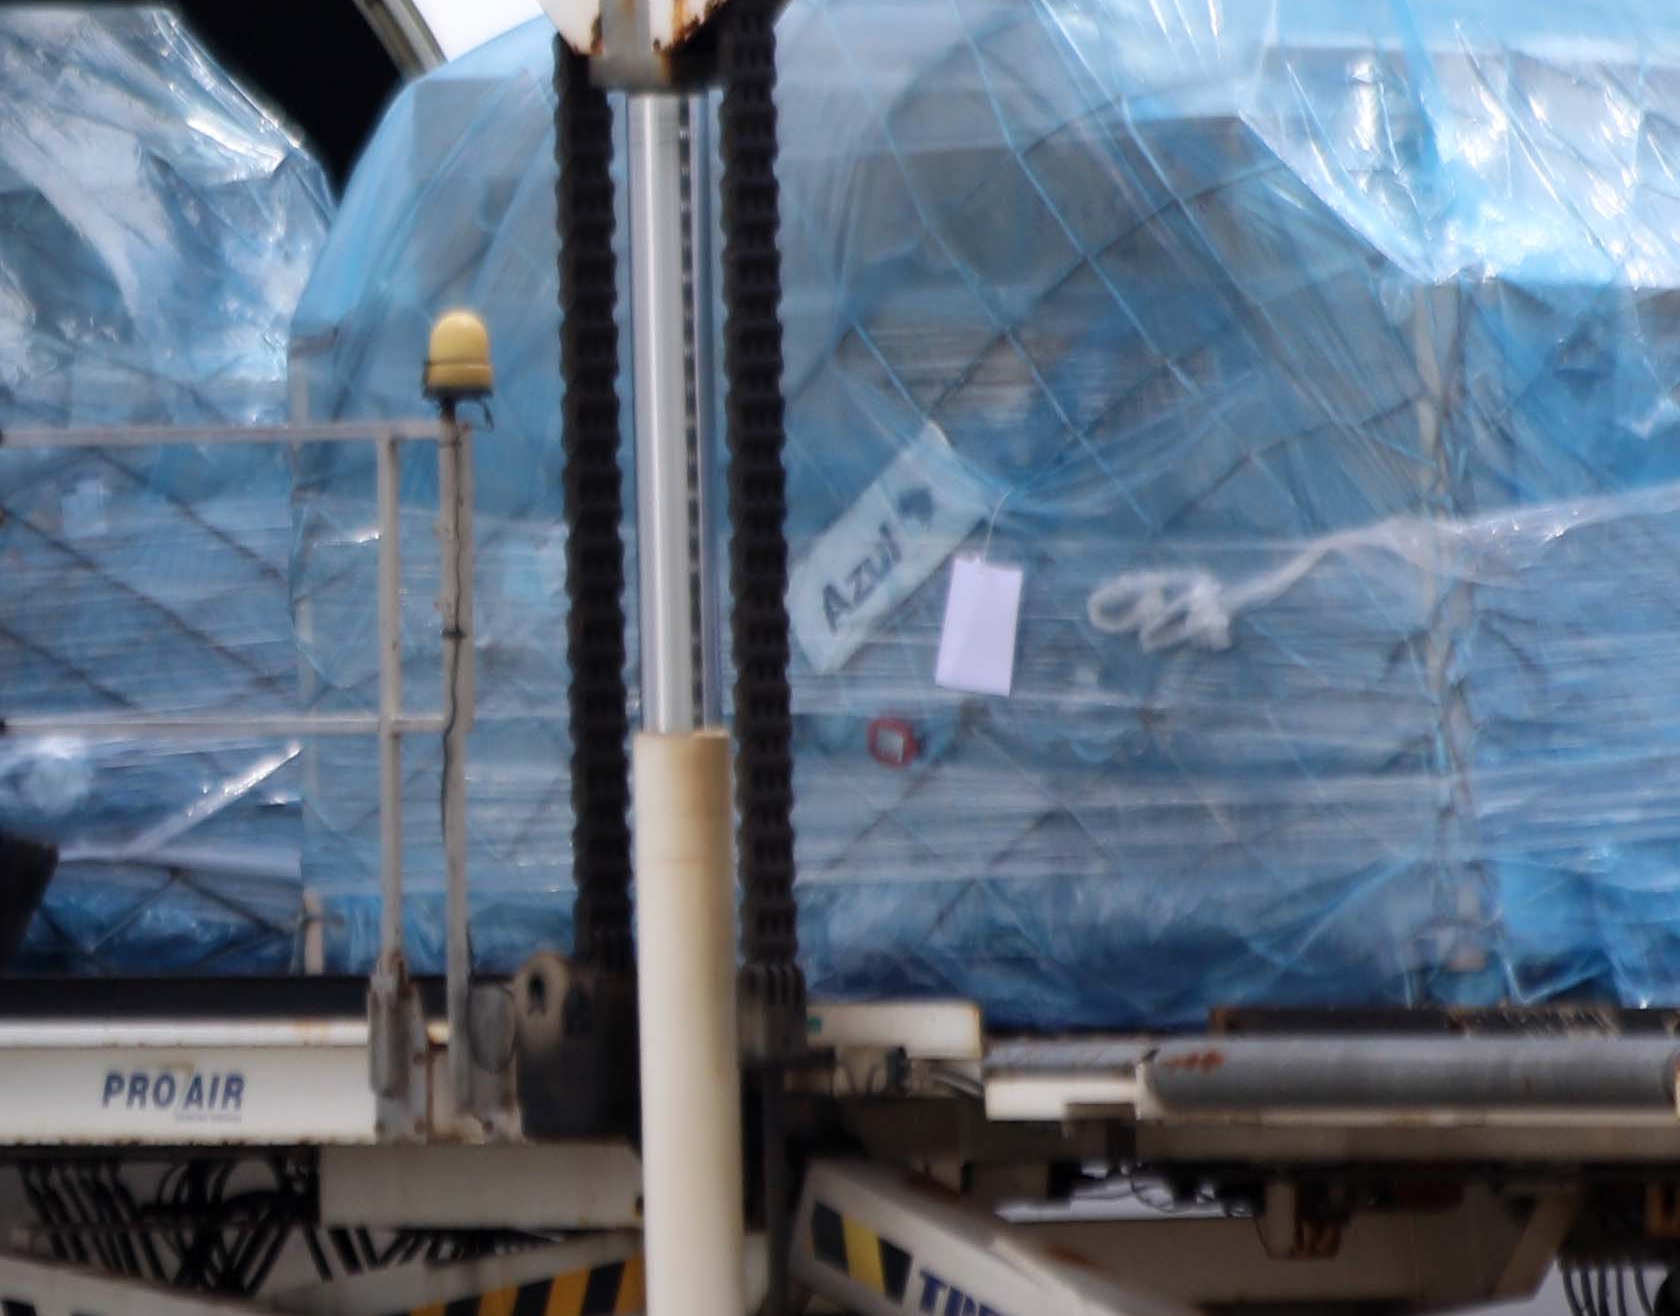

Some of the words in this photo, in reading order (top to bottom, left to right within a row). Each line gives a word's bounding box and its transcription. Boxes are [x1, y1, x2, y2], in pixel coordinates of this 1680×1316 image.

[821, 522, 902, 633] Azul
[101, 1071, 177, 1110] PRO
[182, 1072, 247, 1112] AIR
